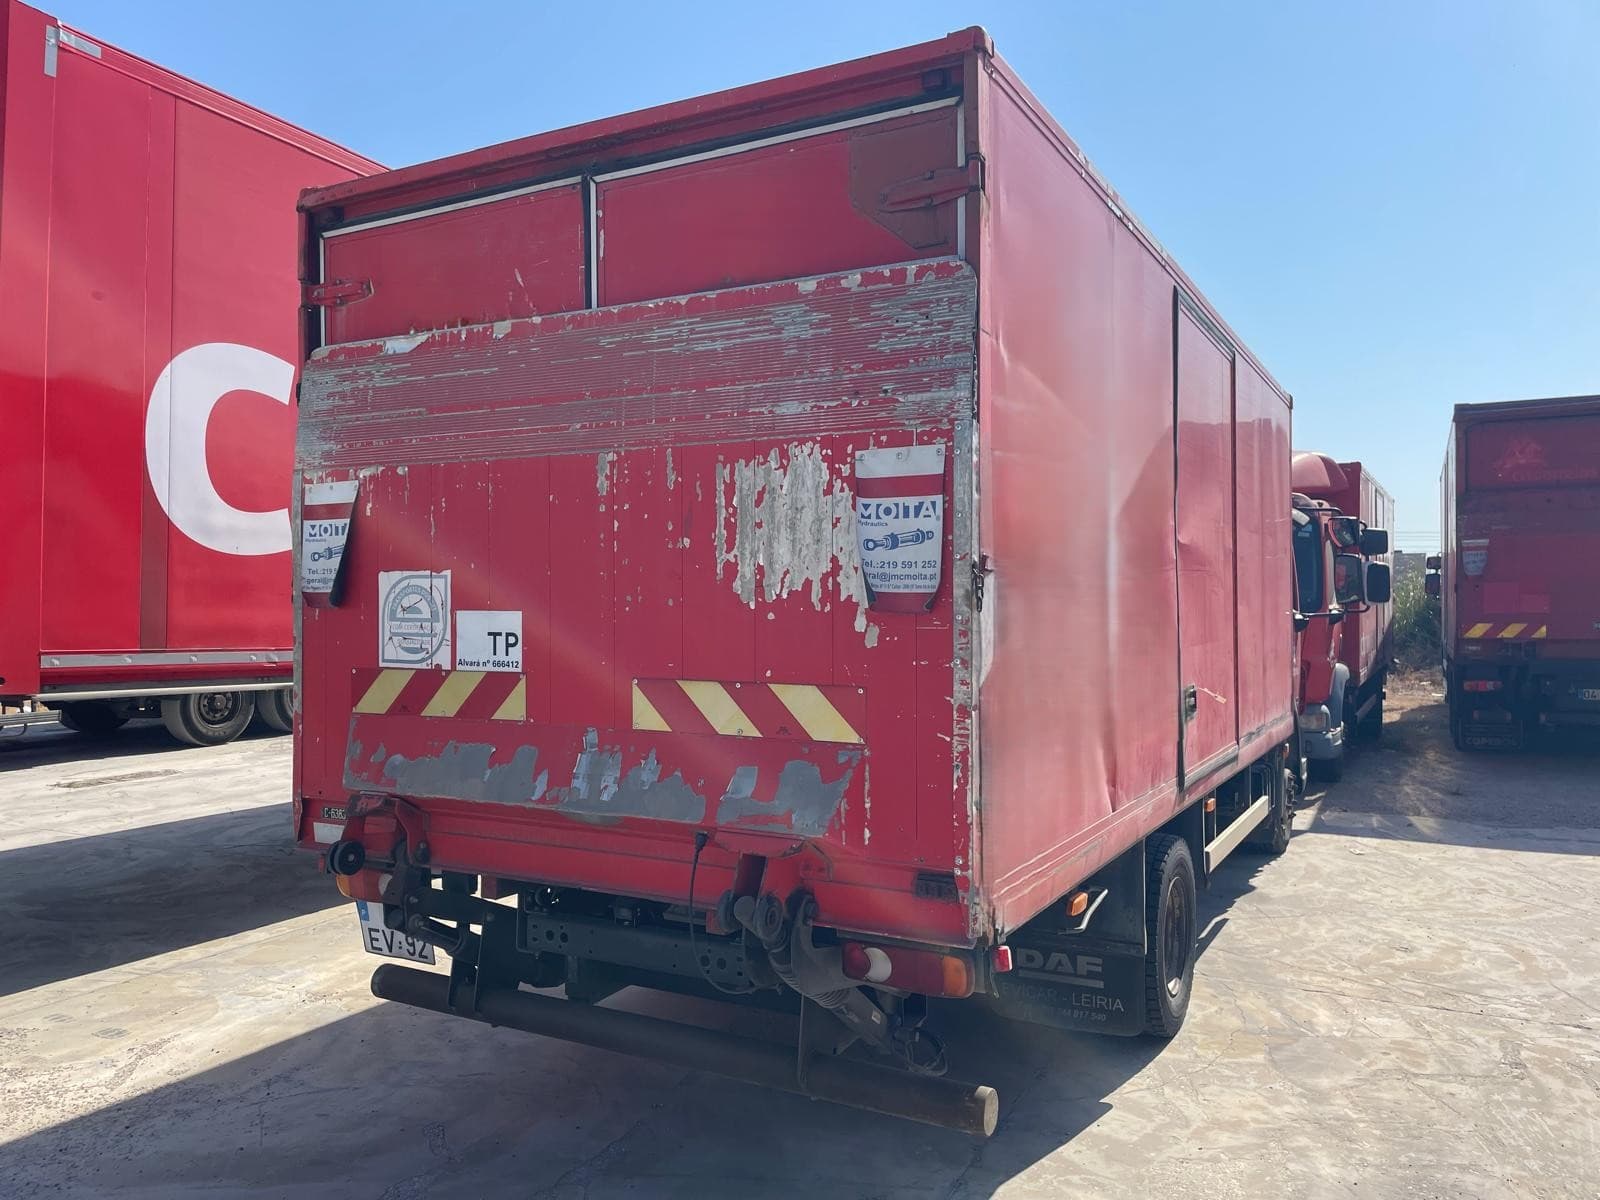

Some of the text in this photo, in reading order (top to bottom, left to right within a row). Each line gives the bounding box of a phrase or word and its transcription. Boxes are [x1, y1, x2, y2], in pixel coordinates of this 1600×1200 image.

[859, 501, 937, 520] MOITA
[306, 523, 347, 537] MOIT
[901, 560, 918, 568] 591
[921, 559, 937, 568] 252
[487, 631, 519, 657] TP
[458, 658, 480, 667] Alvará
[492, 660, 519, 669] 666412
[1016, 947, 1103, 976] DAF
[1072, 991, 1125, 1012] LEIRIA
